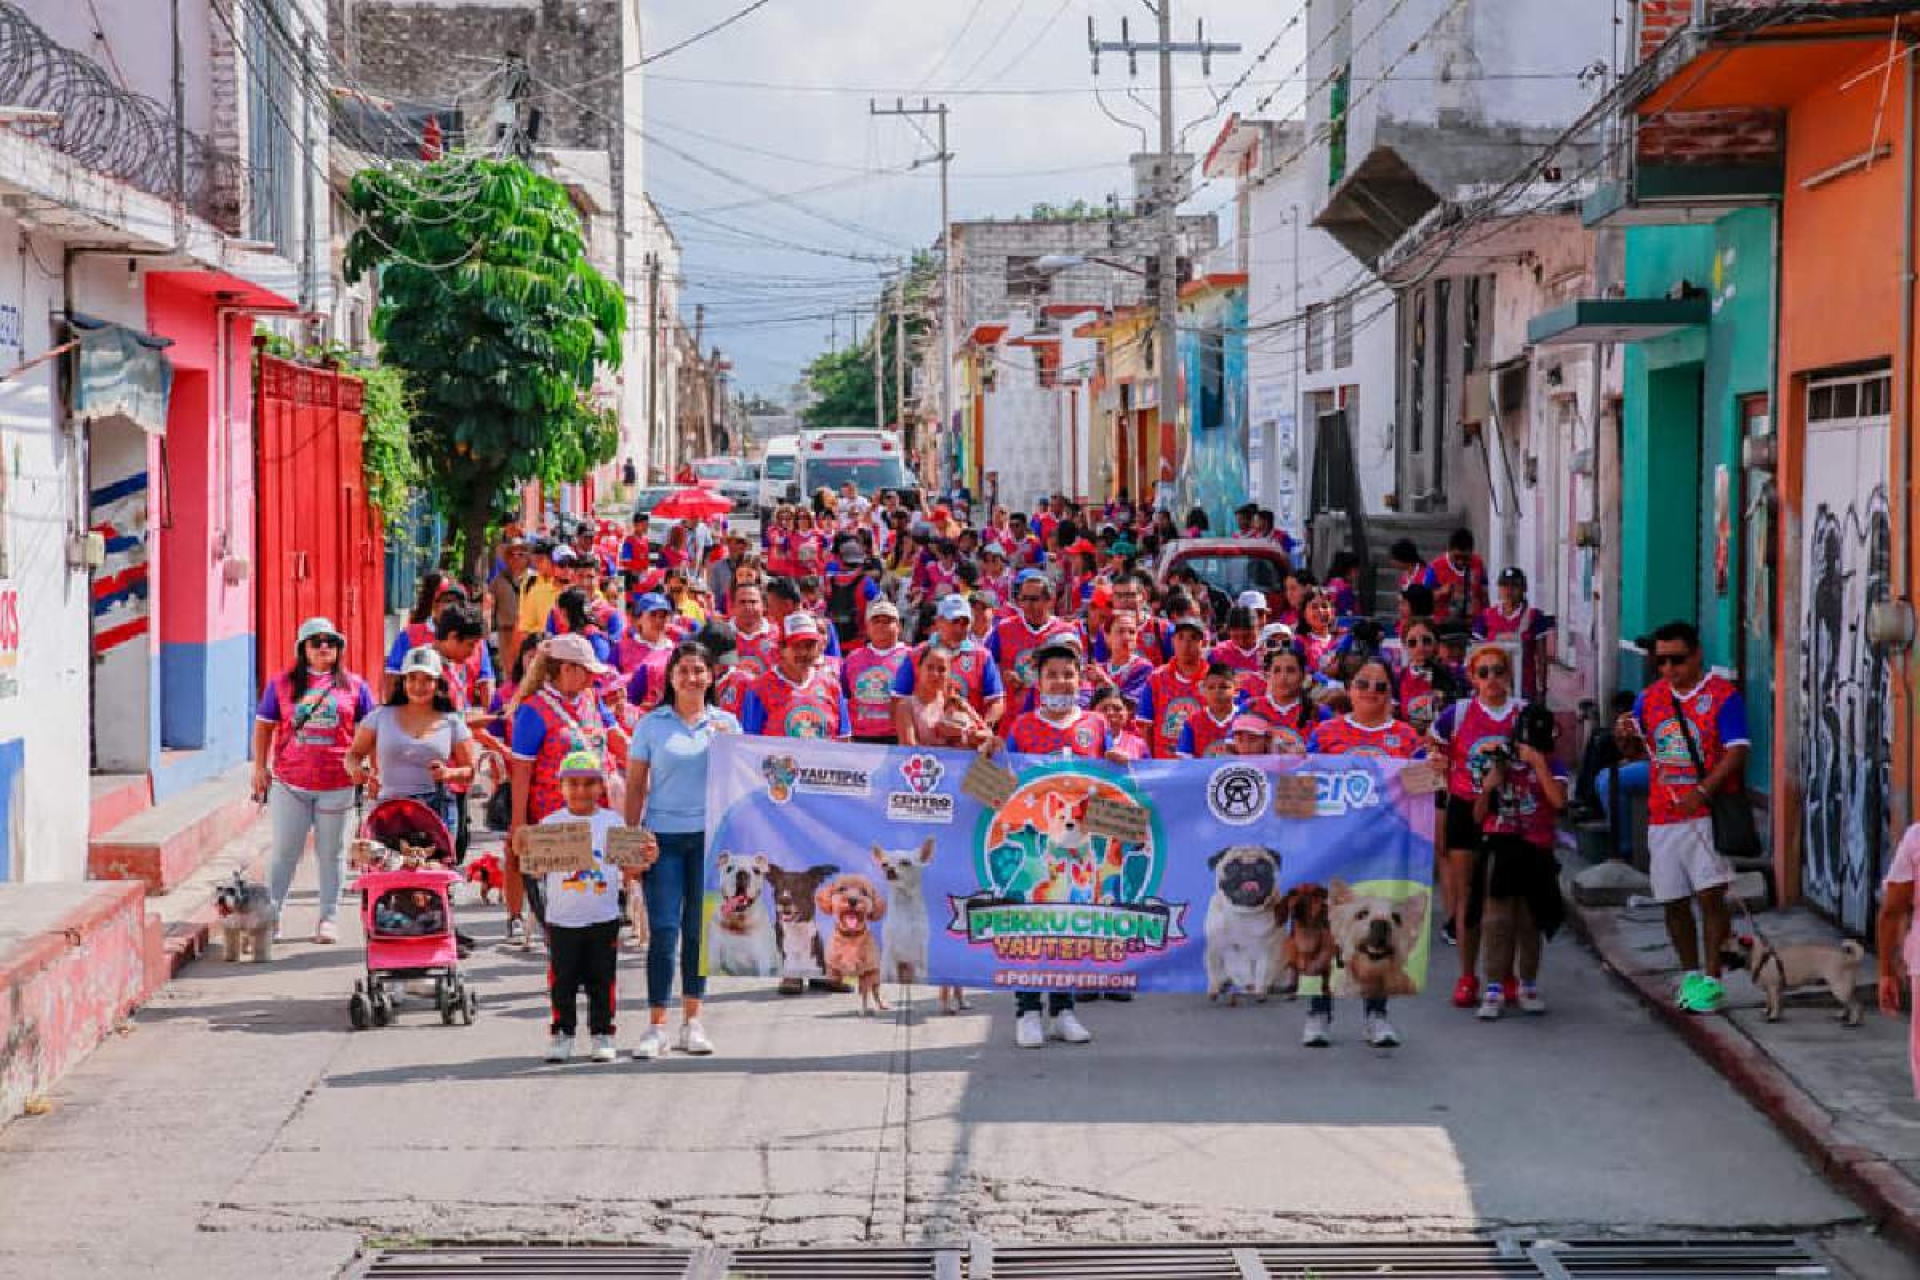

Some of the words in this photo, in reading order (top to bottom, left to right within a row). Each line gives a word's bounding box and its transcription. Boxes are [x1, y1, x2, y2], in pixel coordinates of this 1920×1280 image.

[893, 793, 951, 808] CENTRO
[970, 907, 1162, 939] PERRUCHON
[992, 935, 1127, 961] YAUTEPEC
